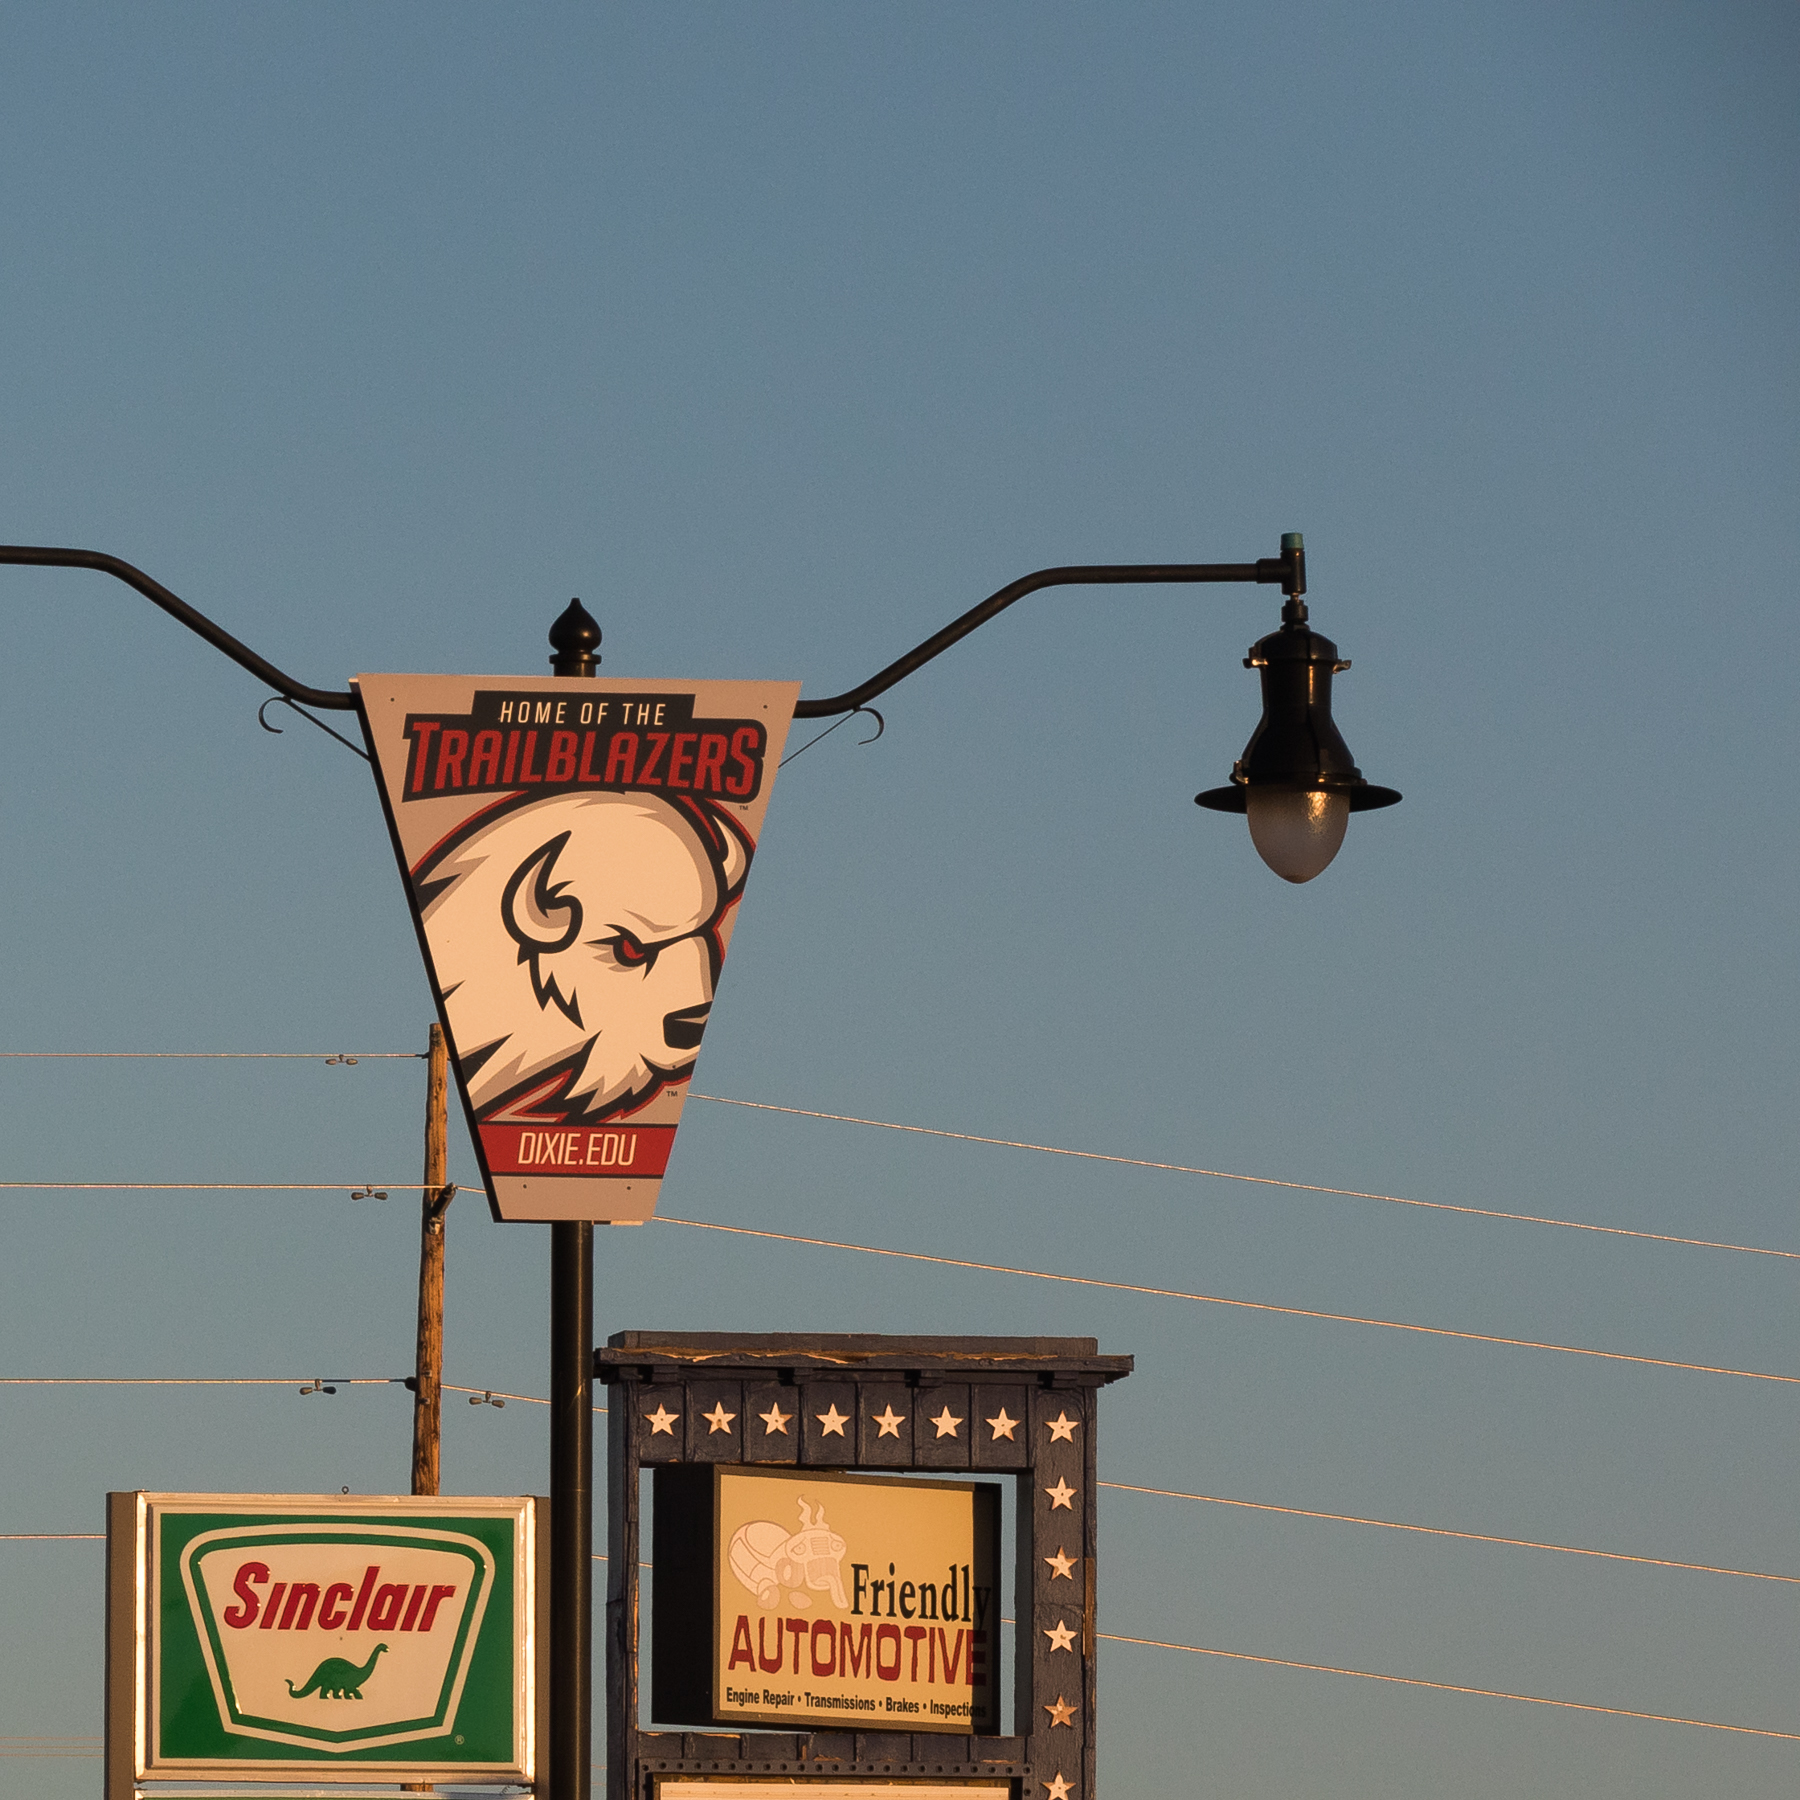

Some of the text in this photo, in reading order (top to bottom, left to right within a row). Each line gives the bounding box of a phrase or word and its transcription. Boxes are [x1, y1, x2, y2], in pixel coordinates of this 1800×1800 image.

[499, 701, 667, 726] HOME OF THE
[411, 720, 760, 796] TRAILBLAZERS
[517, 1131, 637, 1166] DIXIE.EDU
[223, 1561, 456, 1632] Sinclair
[849, 1561, 992, 1628] Friendly
[728, 1614, 988, 1687] AUTOMOTIVE
[726, 1687, 986, 1719] Engine Repair Transmissions Brakes Inspections
